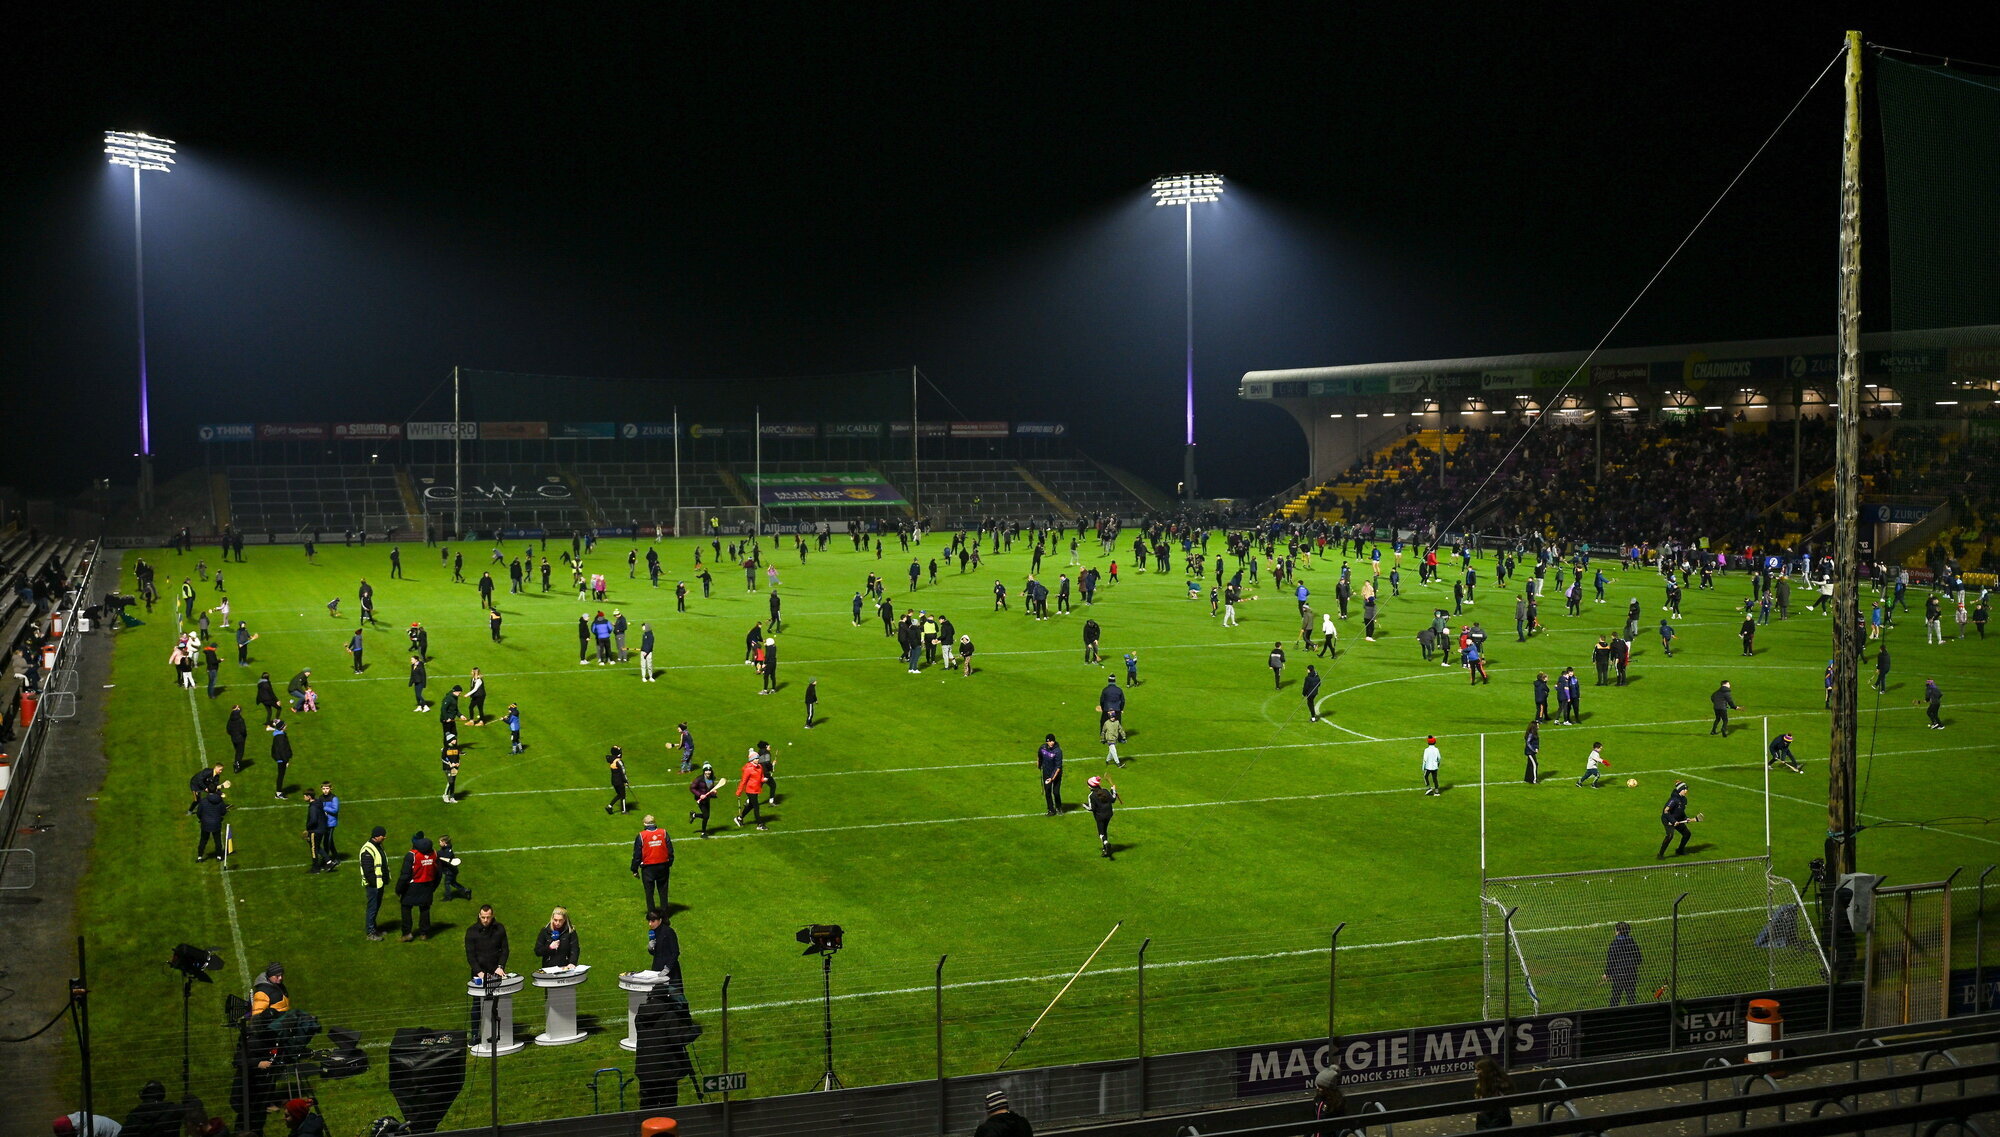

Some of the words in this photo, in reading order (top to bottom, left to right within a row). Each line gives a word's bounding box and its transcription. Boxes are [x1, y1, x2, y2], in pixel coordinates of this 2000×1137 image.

[1693, 361, 1751, 378] CHADWICKS
[1811, 359, 1837, 372] ZUR
[215, 425, 254, 435] THINK
[349, 423, 387, 435] SENATOR
[408, 423, 476, 435] WHITFORD
[641, 426, 680, 436] ZURICH
[1894, 510, 1929, 520] ZURICH
[763, 522, 798, 533] Allianz
[1690, 1028, 1745, 1043] HOME
[1248, 1036, 1408, 1082] MAGGIE
[1424, 1023, 1535, 1062] MAYS
[1341, 1070, 1382, 1085] MONCK
[1386, 1066, 1427, 1080] STRET,
[1430, 1060, 1476, 1074] WEXFOR
[718, 1074, 745, 1090] EXIT
